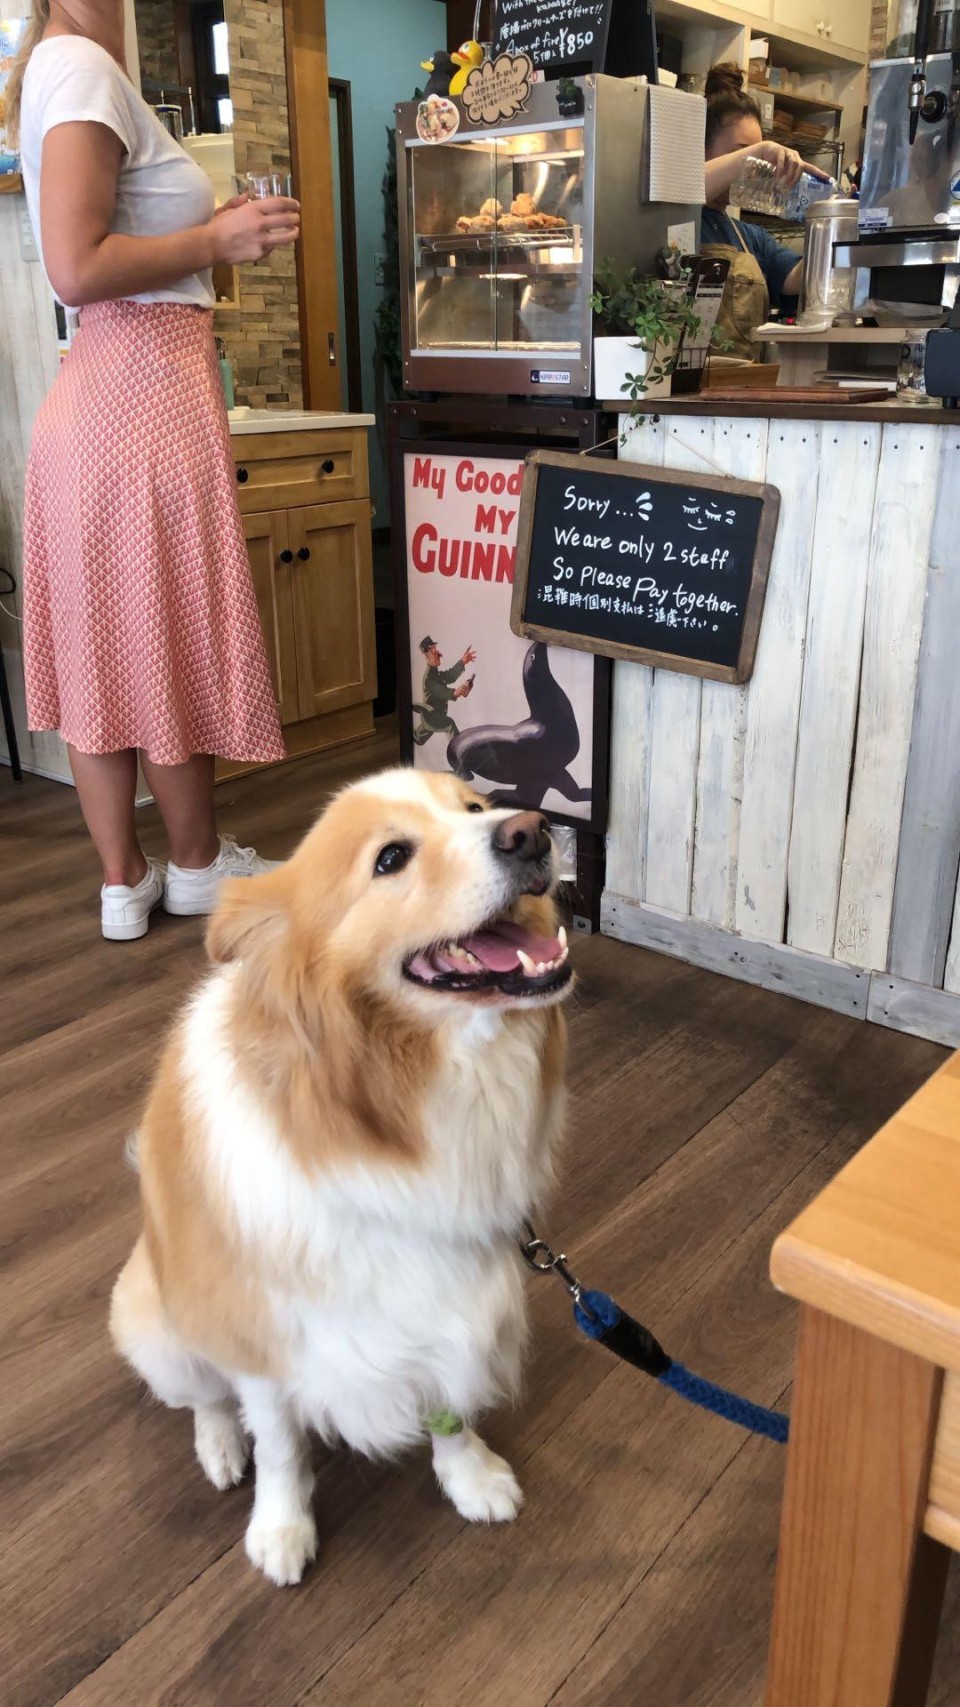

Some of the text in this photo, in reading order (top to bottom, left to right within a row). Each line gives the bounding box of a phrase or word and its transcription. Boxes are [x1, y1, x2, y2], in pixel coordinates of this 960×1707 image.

[559, 27, 594, 58] ¥850
[412, 457, 446, 500] My
[474, 504, 517, 535] MY
[618, 534, 655, 564] only
[663, 541, 677, 562] 2
[552, 556, 574, 581] So
[632, 577, 669, 606] Pay
